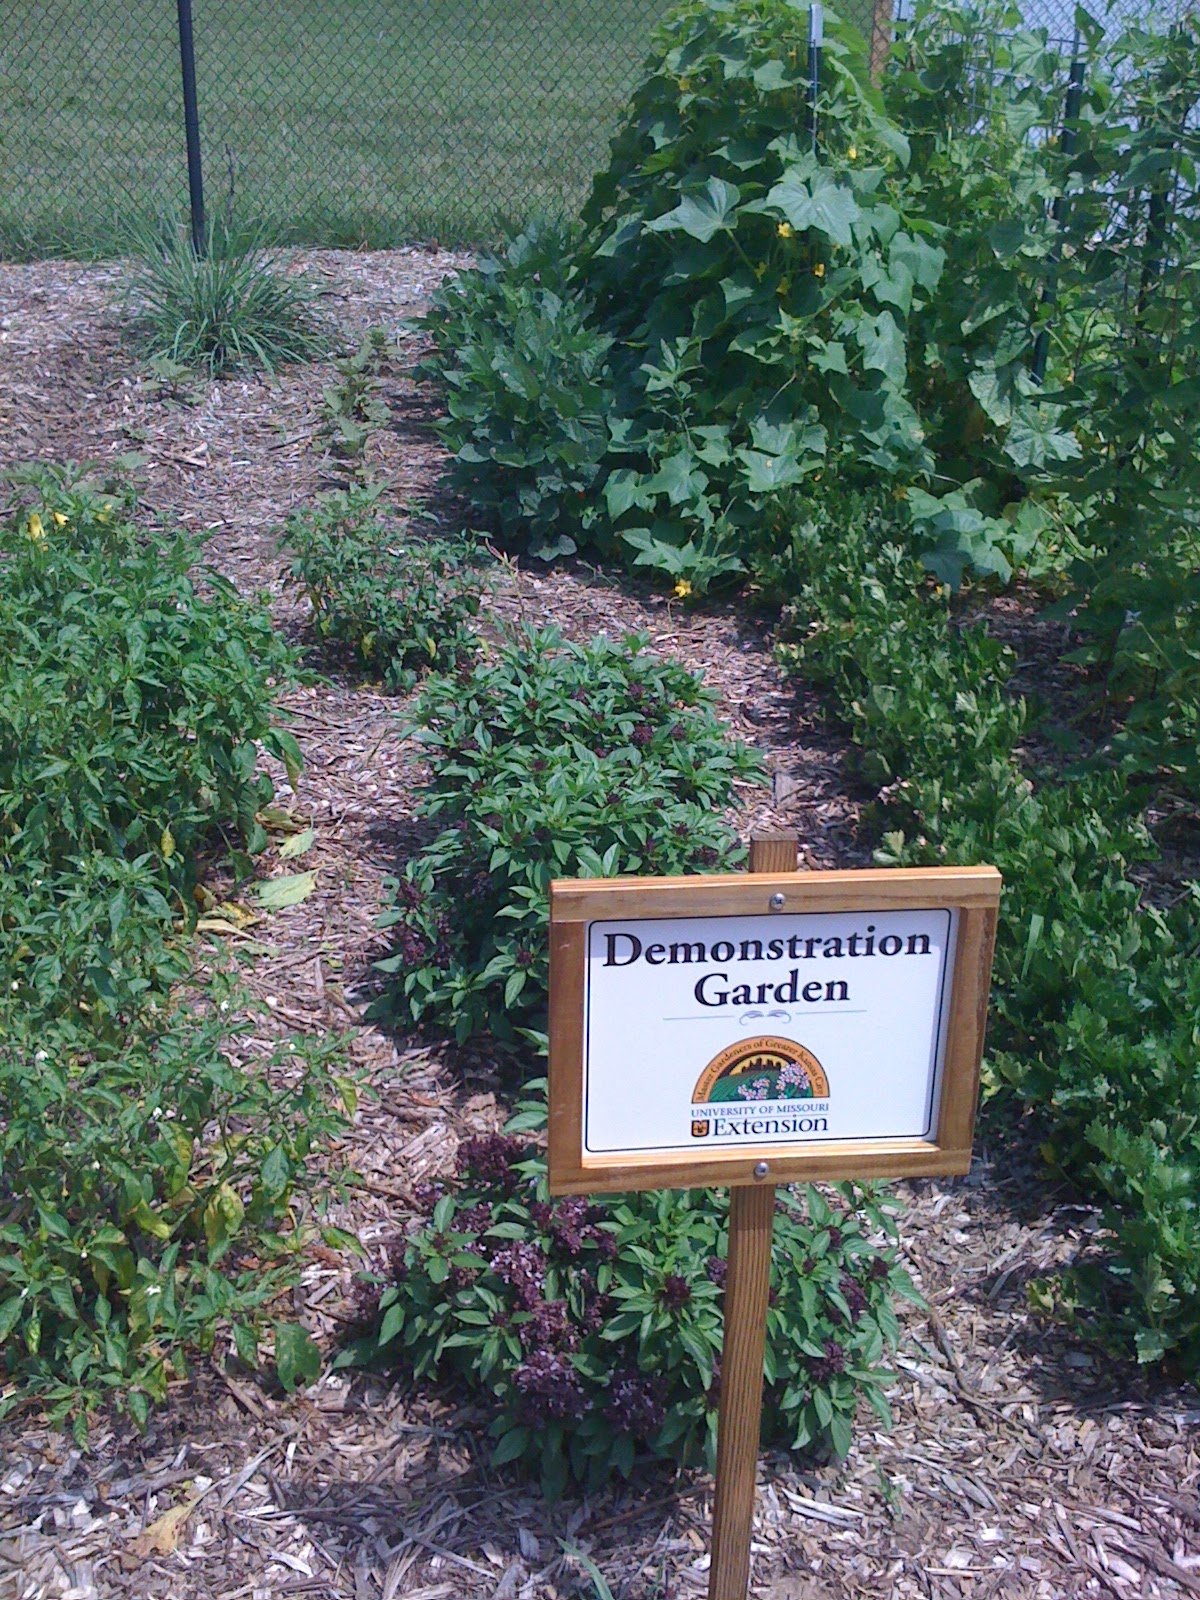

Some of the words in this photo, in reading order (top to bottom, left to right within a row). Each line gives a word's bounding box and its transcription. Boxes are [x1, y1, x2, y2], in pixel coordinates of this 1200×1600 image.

[602, 925, 932, 967] Demonstration
[694, 968, 850, 1007] Garden
[697, 1073, 714, 1101] Master
[712, 1043, 752, 1073] Gardeners
[753, 1038, 765, 1048] of
[765, 1039, 798, 1054] Greater
[798, 1051, 818, 1077] Kansas
[814, 1074, 825, 1095] City
[691, 1106, 757, 1118] UNIVERSITY
[759, 1105, 774, 1114] OF
[776, 1103, 829, 1113] MISSOURI
[713, 1114, 828, 1136] Extension
